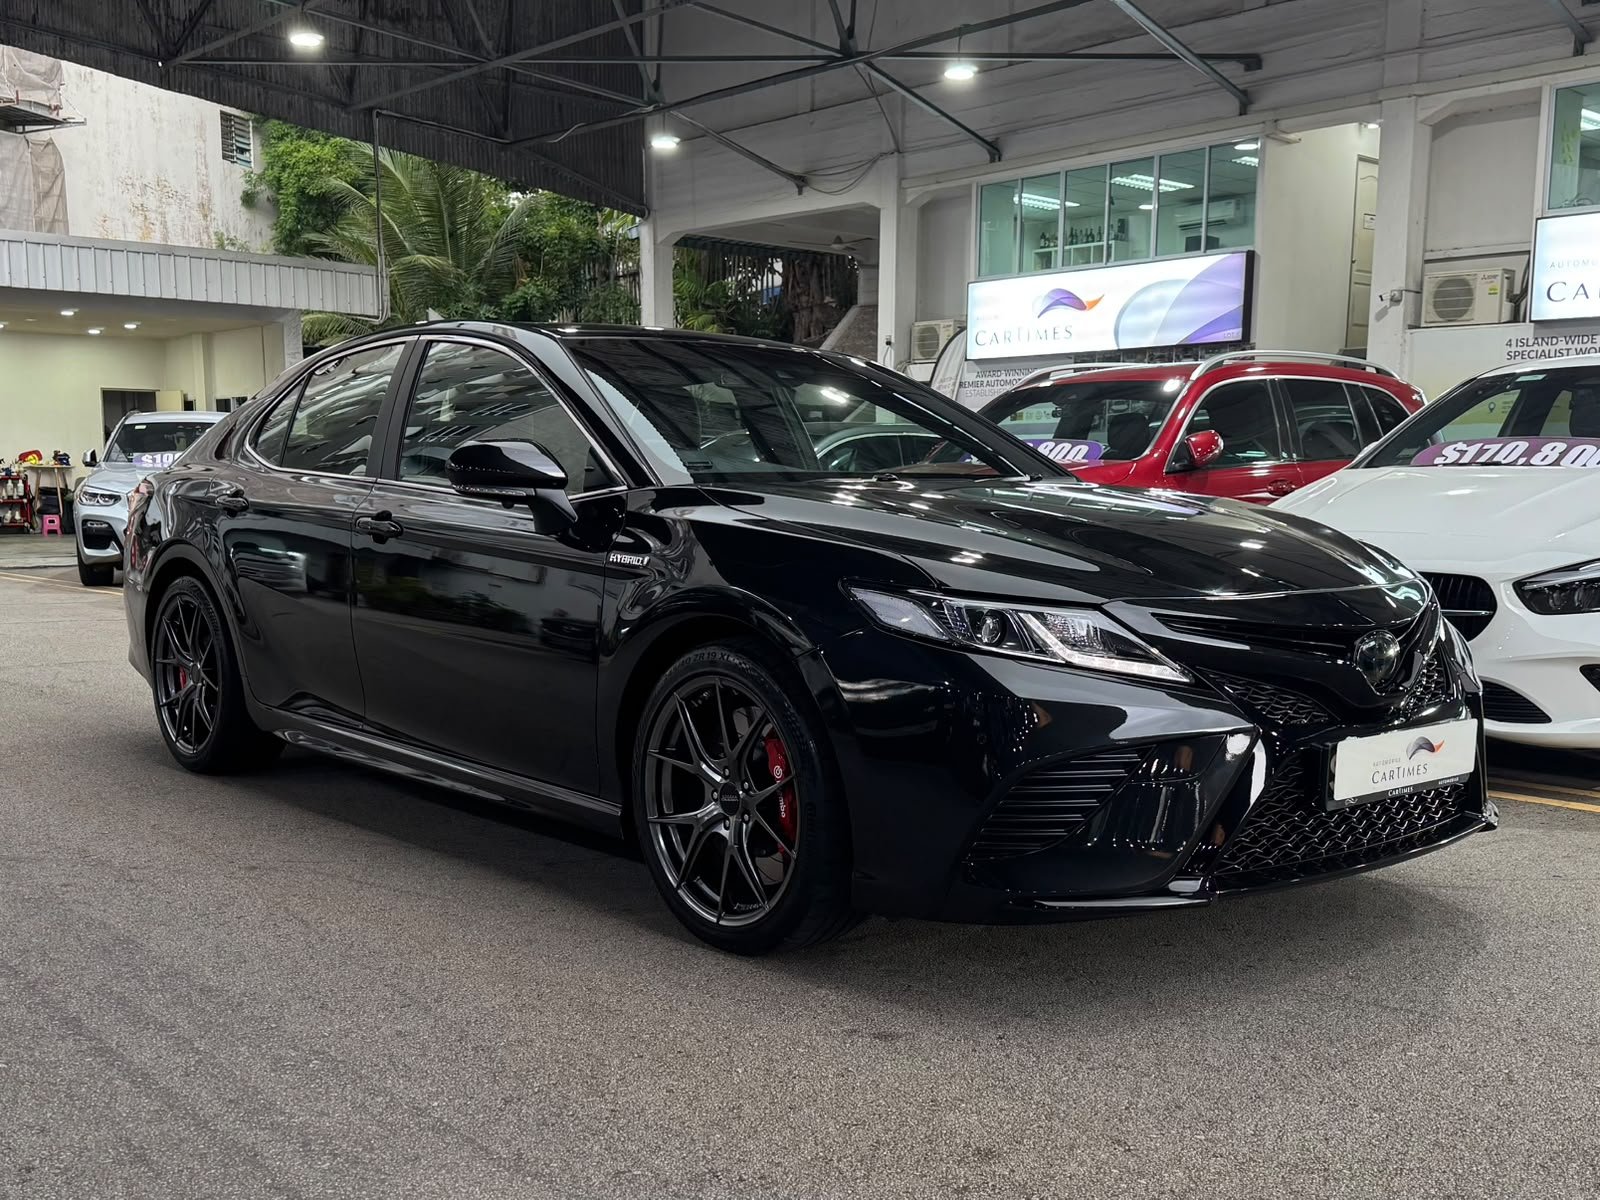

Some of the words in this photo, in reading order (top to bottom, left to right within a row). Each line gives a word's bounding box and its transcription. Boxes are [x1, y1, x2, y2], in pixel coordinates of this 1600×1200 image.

[1546, 281, 1600, 302] CA
[975, 325, 1073, 346] CARTIMES
[1505, 338, 1513, 348] 4
[1515, 334, 1597, 348] ISLAND-WIDE
[1506, 347, 1572, 360] SPECIALIST
[1574, 346, 1600, 356] WO
[975, 367, 1038, 379] AWARD-WINNIN
[960, 379, 985, 389] REMIER
[1027, 441, 1089, 462] 800
[1434, 441, 1600, 468] $170,80
[609, 553, 643, 566] HYBRID
[1371, 763, 1428, 784] CARTIMES
[1388, 786, 1413, 797] CARTIMES
